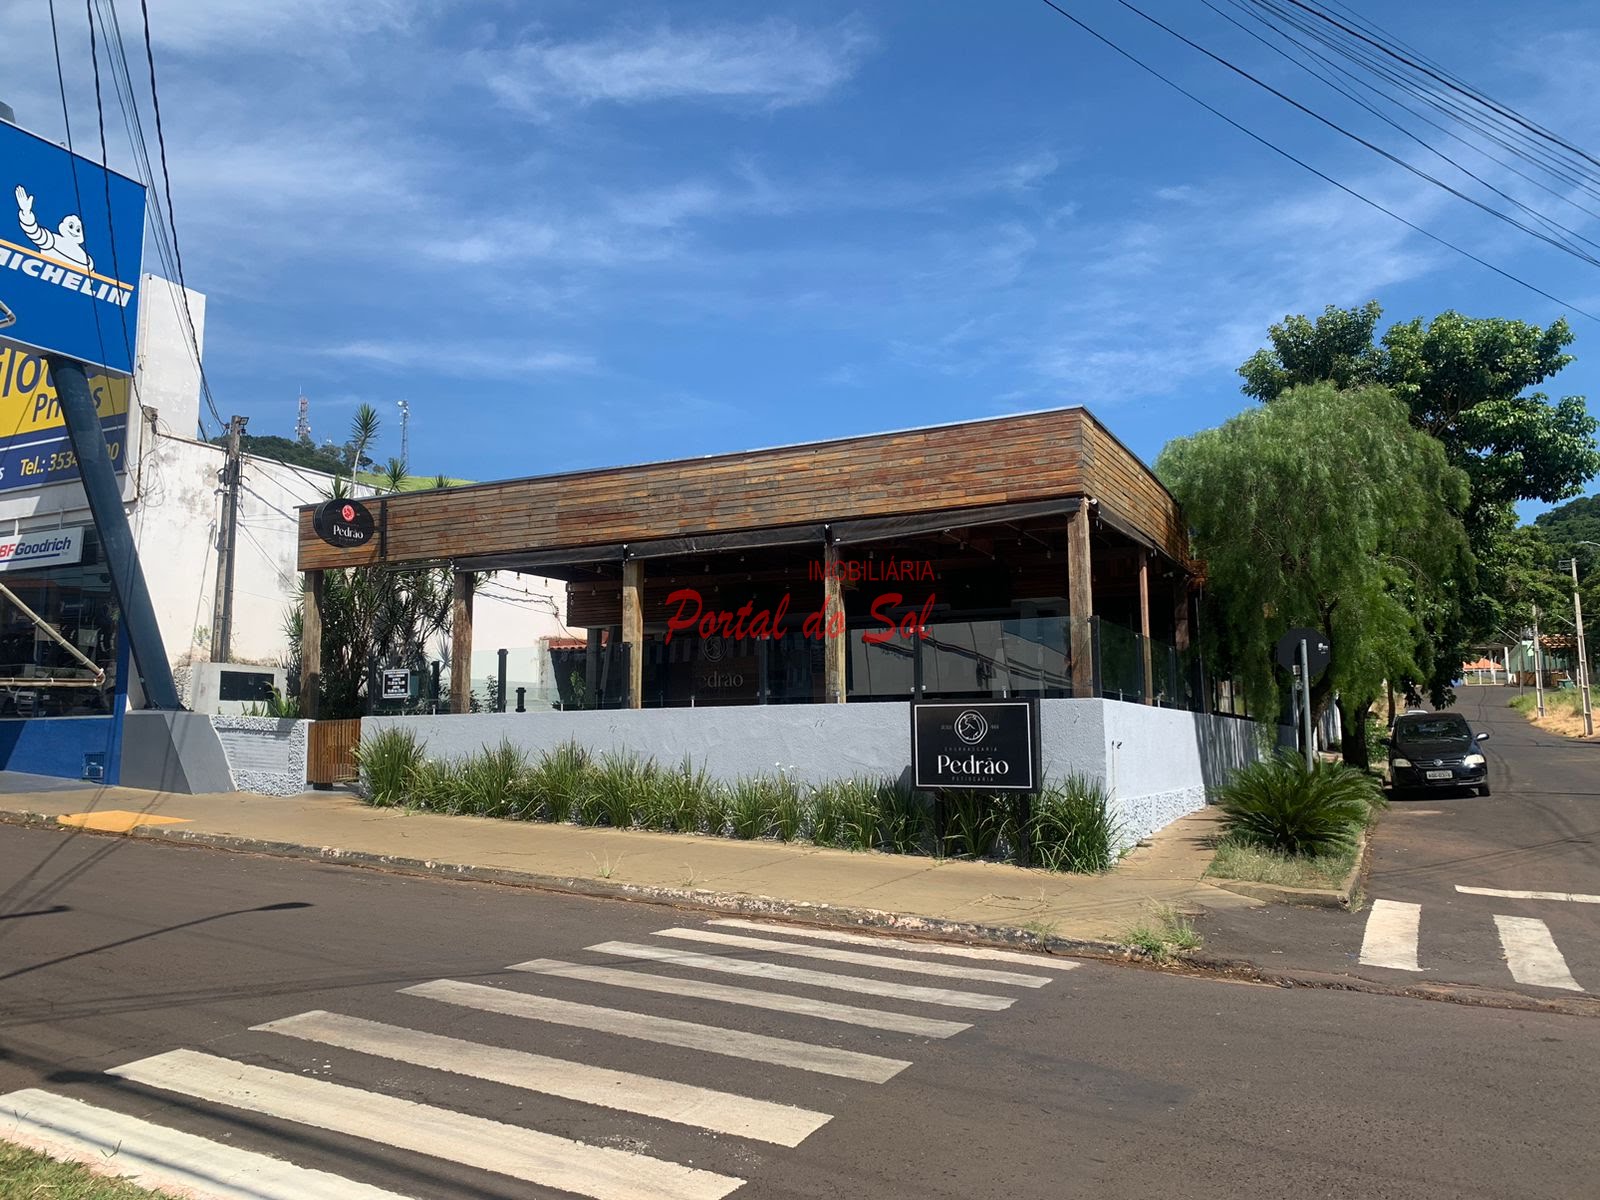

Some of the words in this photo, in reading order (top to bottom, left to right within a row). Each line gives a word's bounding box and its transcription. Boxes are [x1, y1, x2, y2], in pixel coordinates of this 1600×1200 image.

[20, 456, 46, 476] Tel.:
[0, 537, 71, 558] BFGoodrich
[937, 755, 1009, 775] Pedrão
